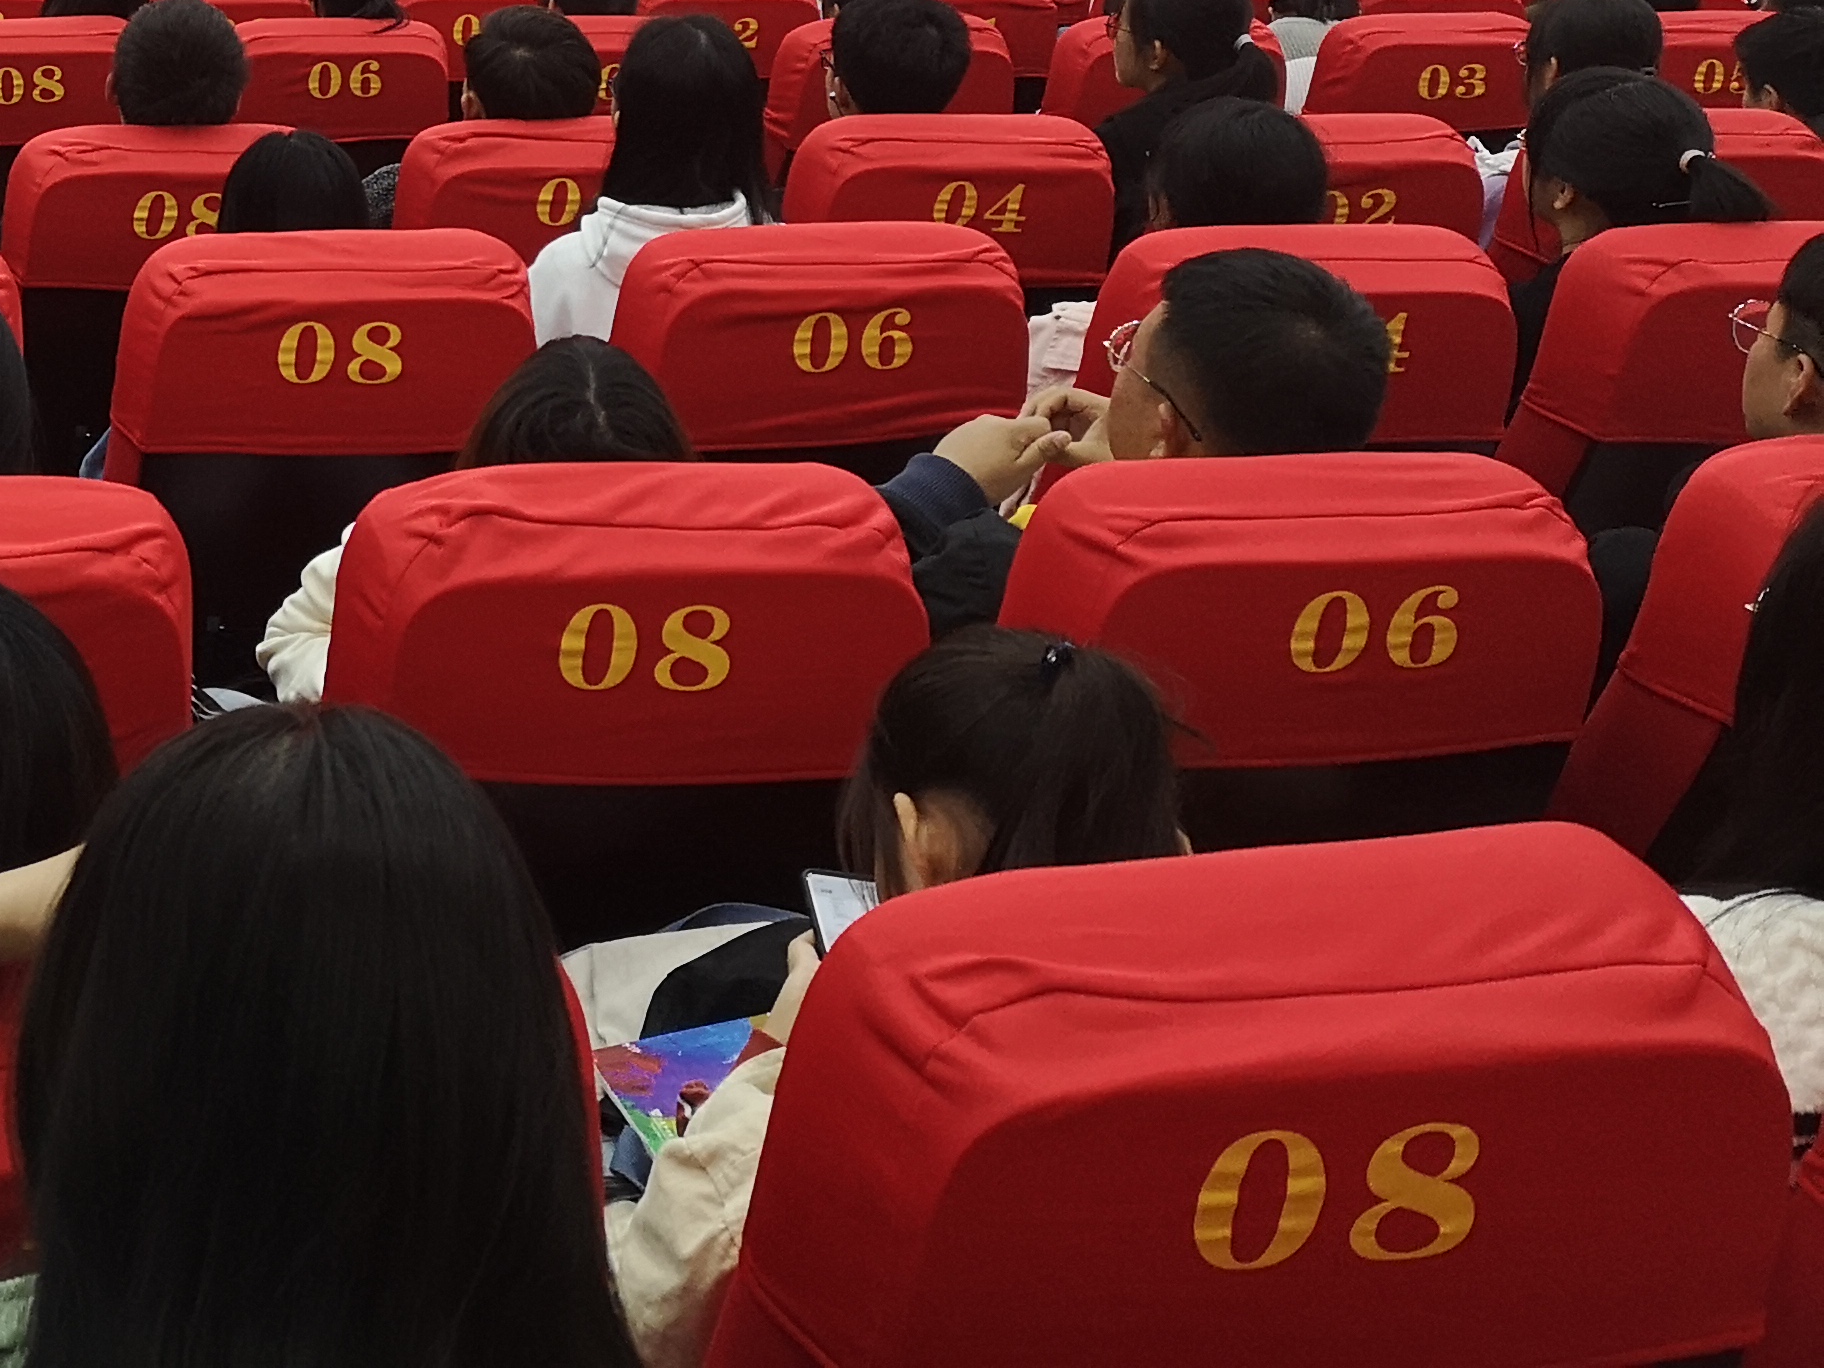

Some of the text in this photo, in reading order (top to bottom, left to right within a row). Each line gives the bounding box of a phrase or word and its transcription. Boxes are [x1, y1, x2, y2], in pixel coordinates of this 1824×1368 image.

[733, 16, 760, 50] 2
[307, 59, 383, 100] 06
[1417, 62, 1488, 100] 03
[534, 176, 582, 227] 0
[932, 180, 1027, 233] 04
[276, 319, 405, 385] 08
[791, 307, 915, 374] 06
[557, 602, 733, 693] 08
[1289, 584, 1461, 674] 06
[1193, 1121, 1481, 1271] 08
